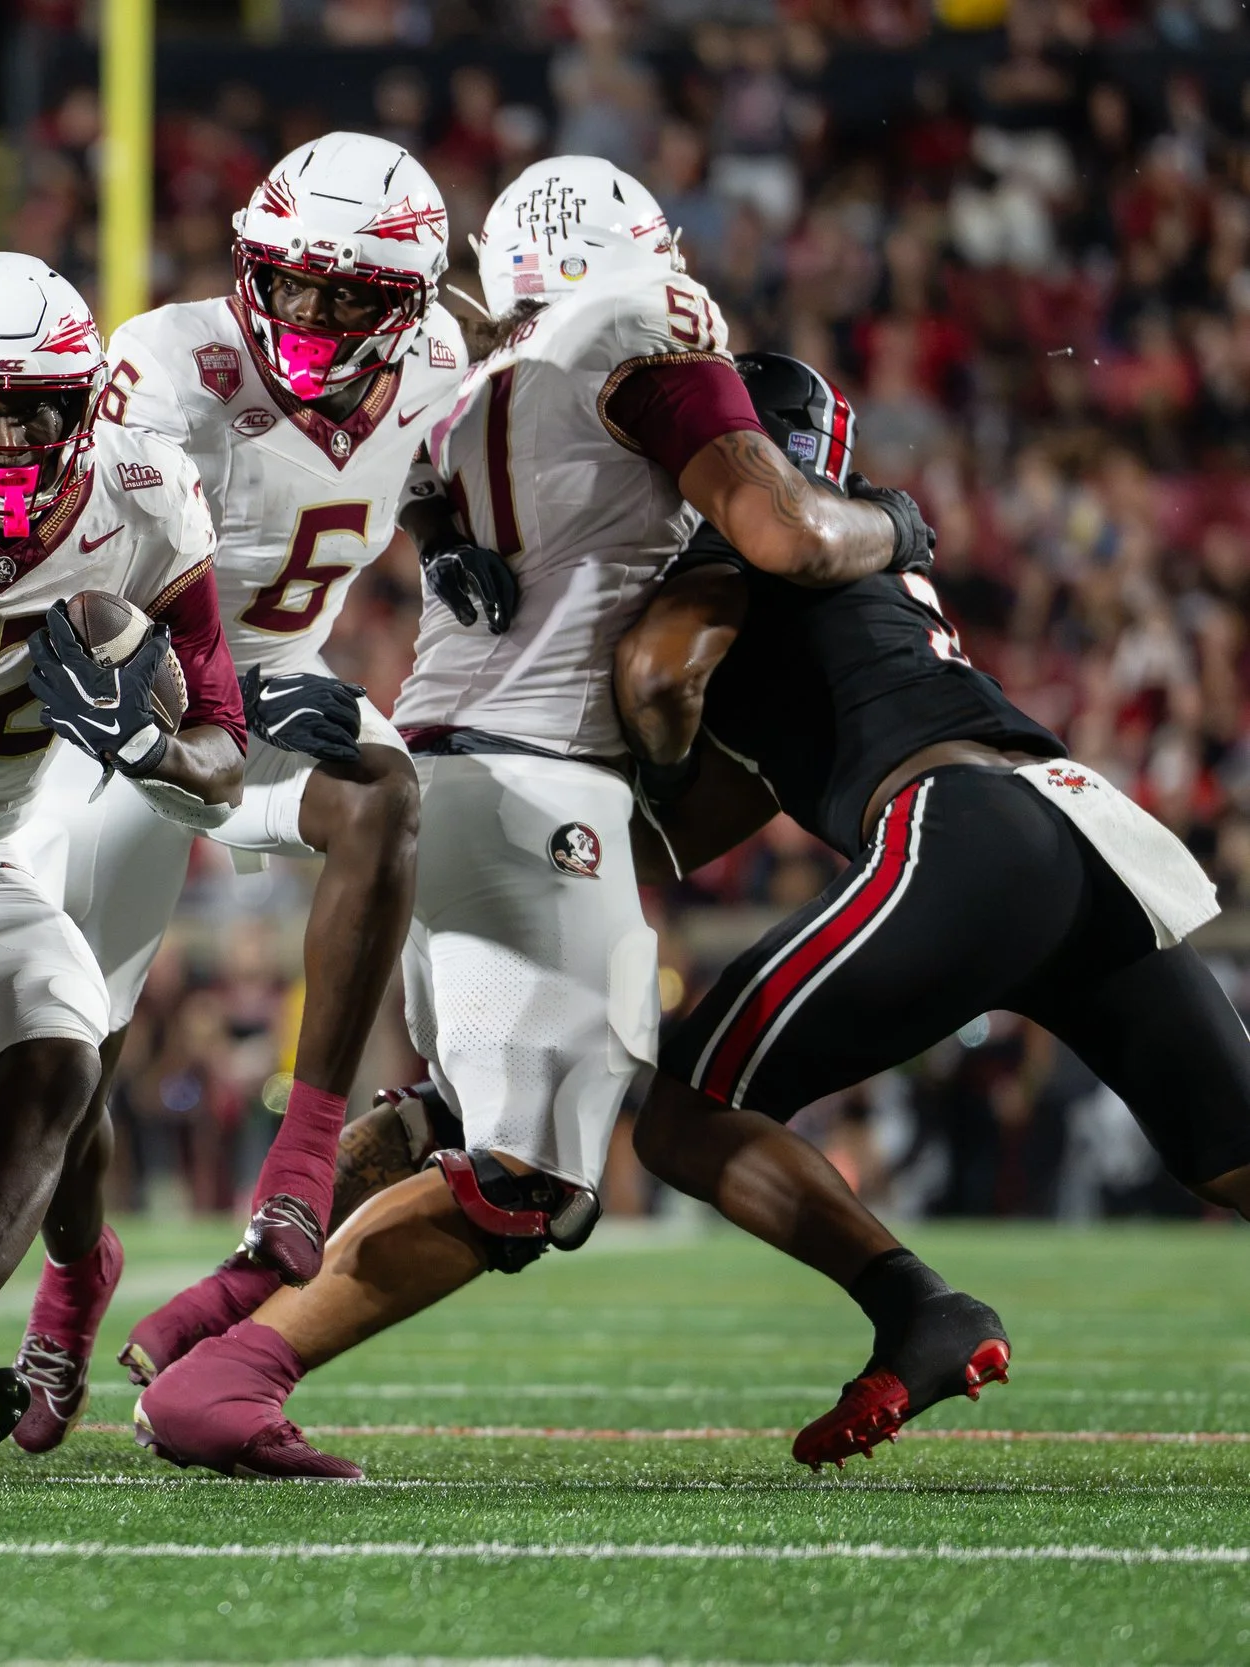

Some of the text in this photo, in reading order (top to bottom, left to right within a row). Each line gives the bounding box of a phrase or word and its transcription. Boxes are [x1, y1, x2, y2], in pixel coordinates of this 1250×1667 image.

[665, 284, 718, 353] 51
[240, 413, 270, 425] ACC
[119, 462, 160, 482] kin.
[124, 477, 161, 489] insurance
[234, 498, 373, 637] 6
